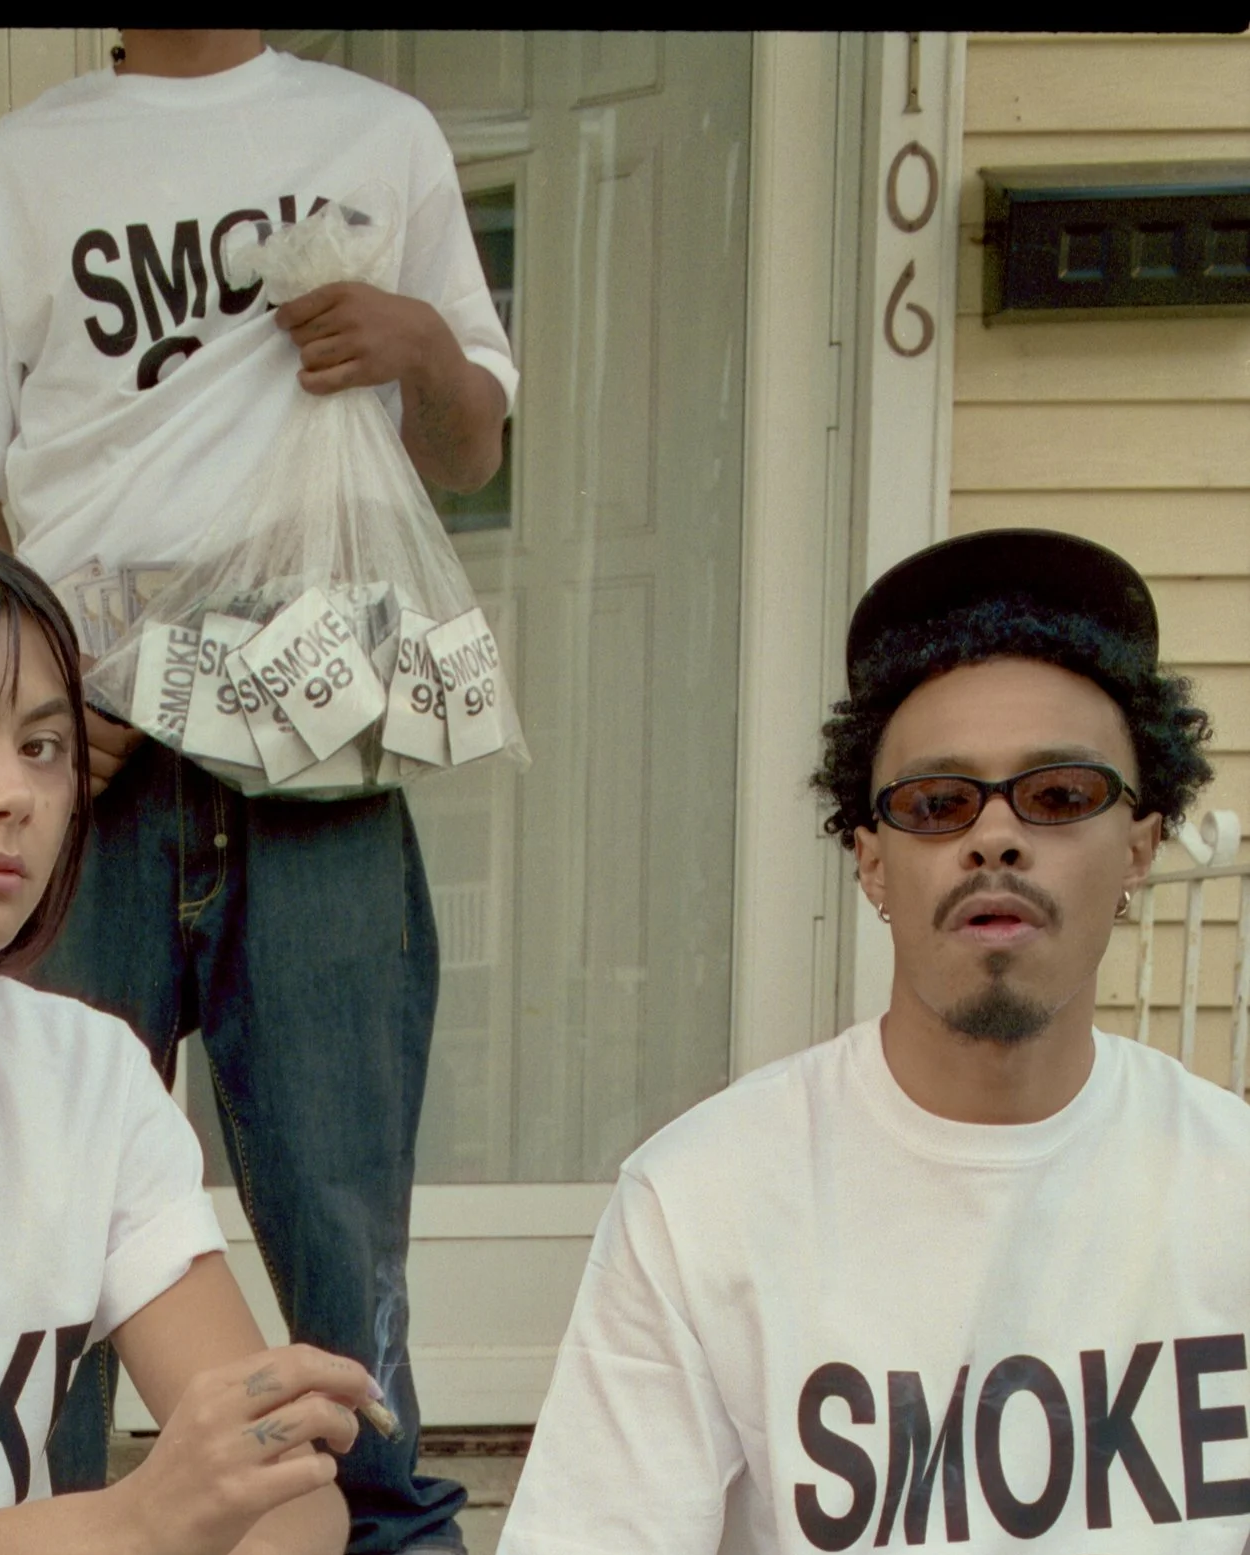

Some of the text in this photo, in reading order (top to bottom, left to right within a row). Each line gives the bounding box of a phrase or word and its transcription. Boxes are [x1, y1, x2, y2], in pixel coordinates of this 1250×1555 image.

[261, 610, 351, 698] SMOKE
[304, 657, 354, 709] 98
[440, 633, 498, 692] SMOKE
[464, 677, 495, 716] 98
[794, 1333, 1250, 1553] SMOKE
